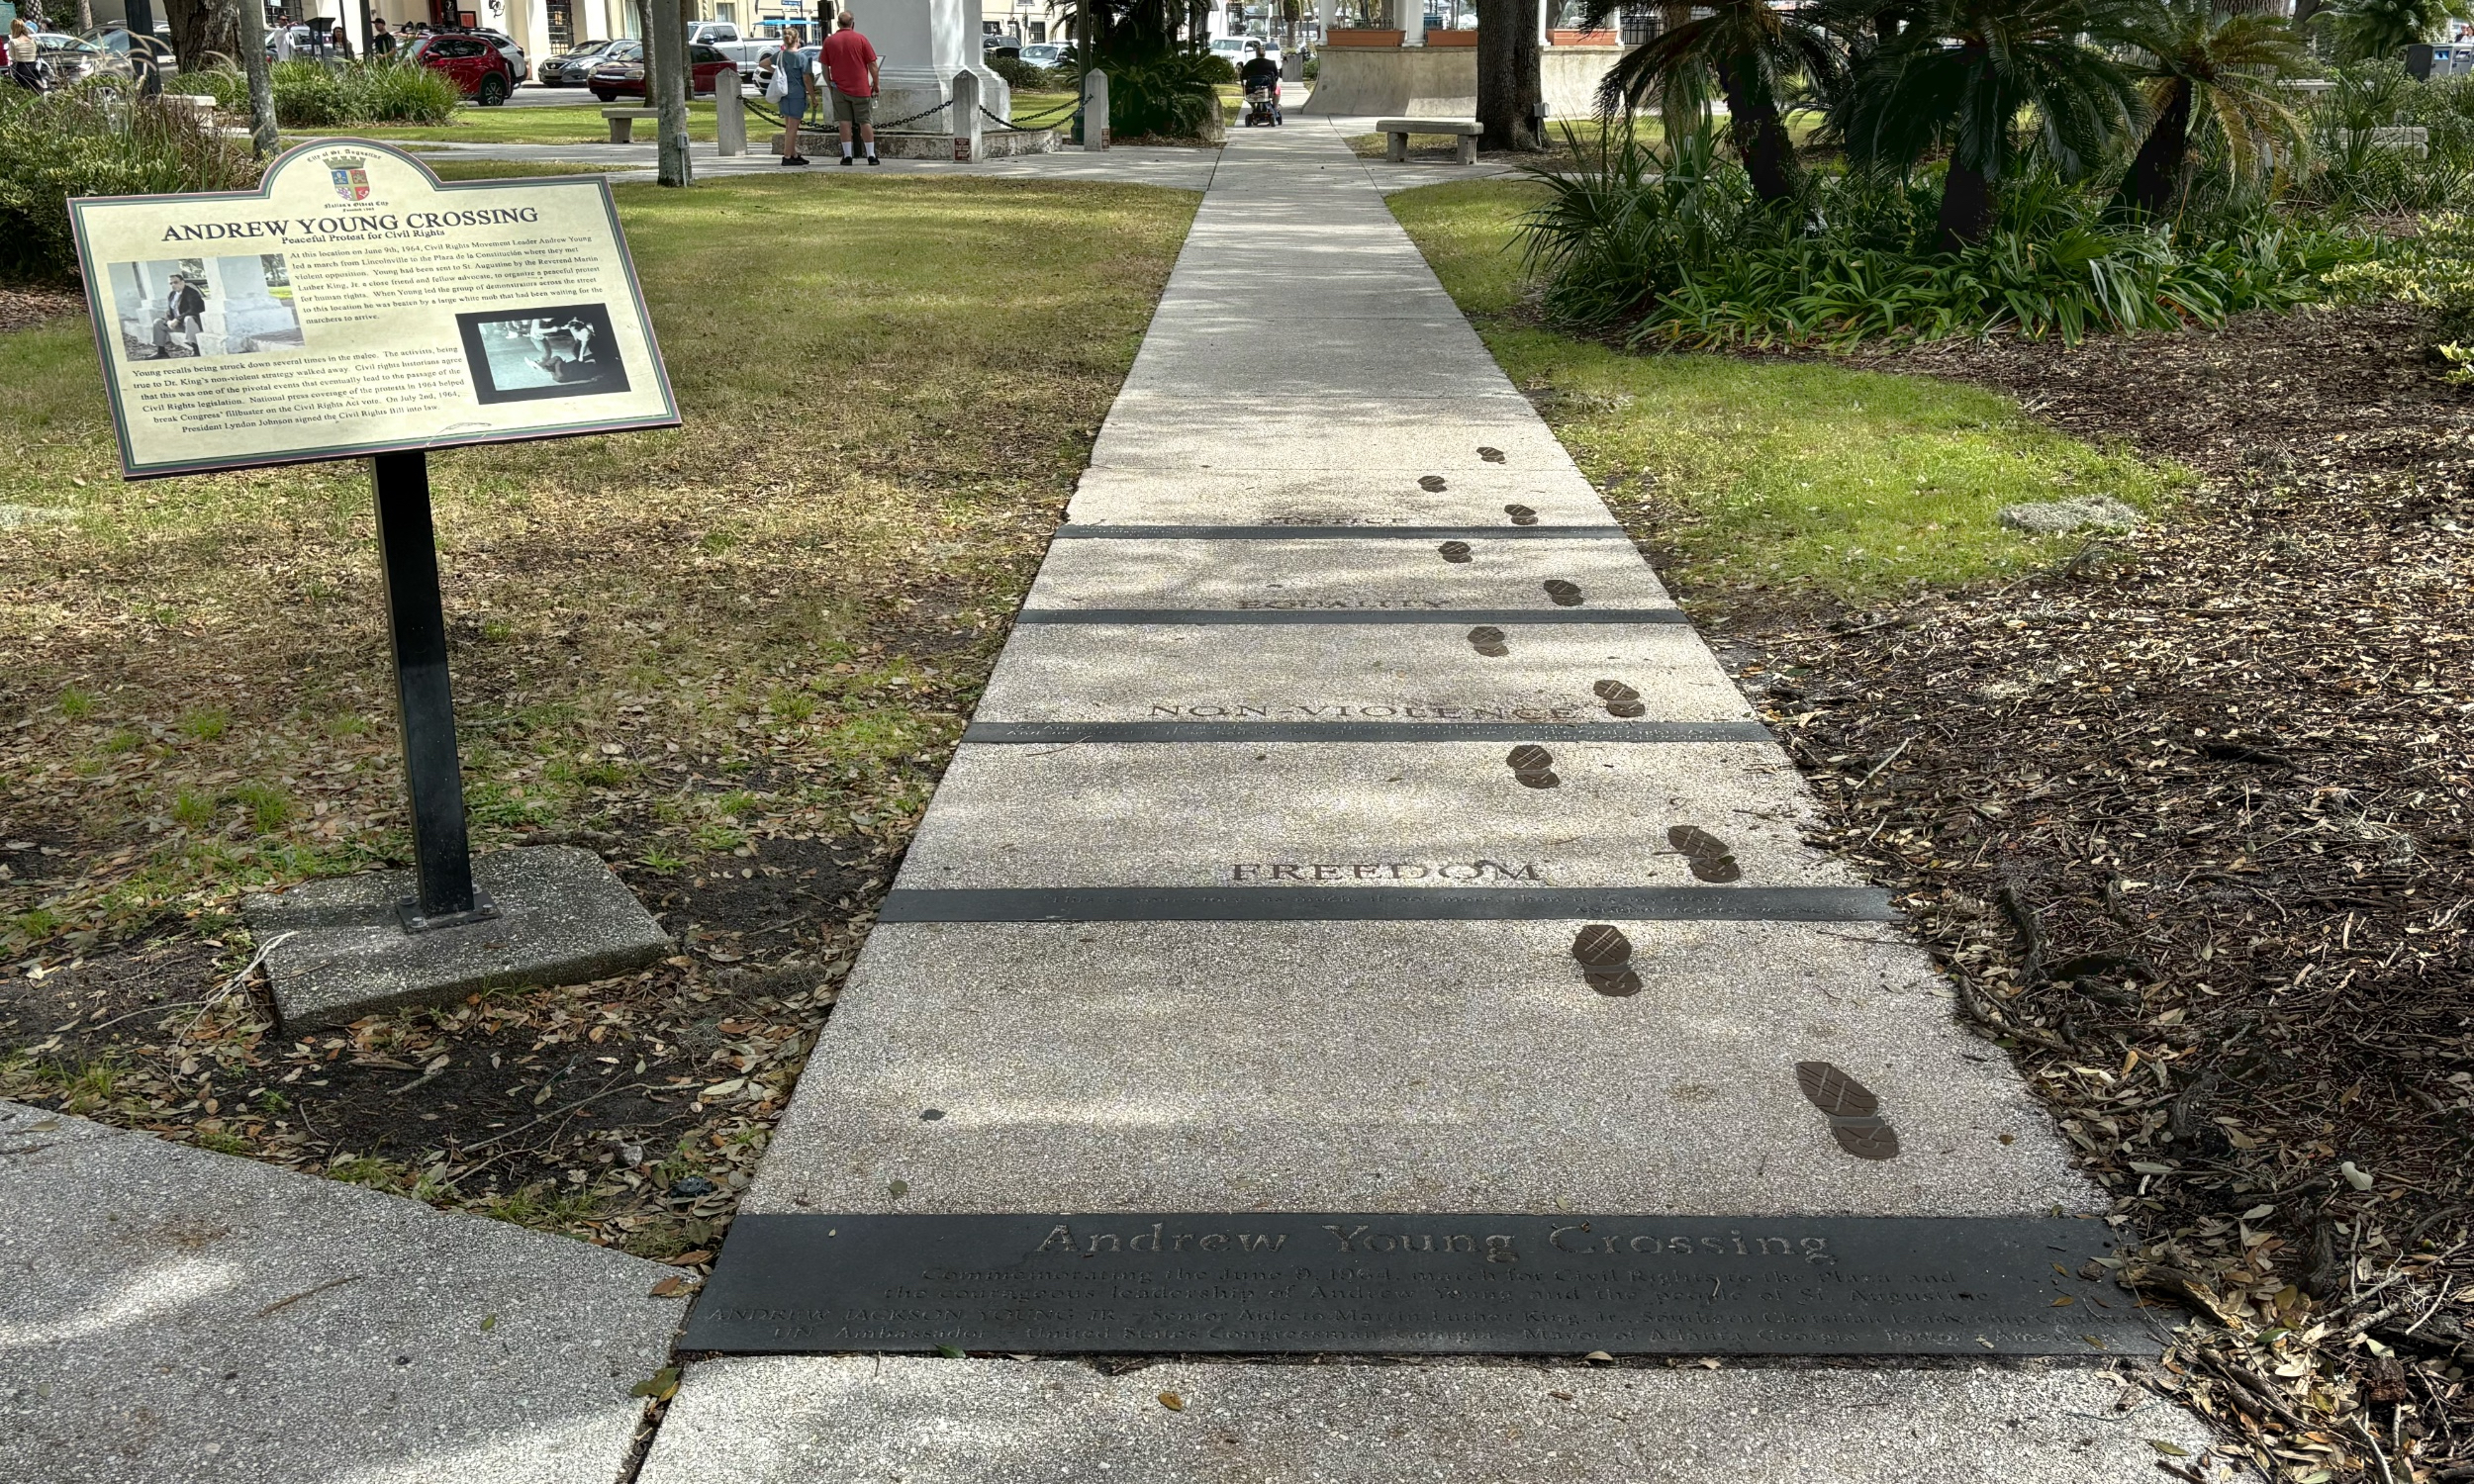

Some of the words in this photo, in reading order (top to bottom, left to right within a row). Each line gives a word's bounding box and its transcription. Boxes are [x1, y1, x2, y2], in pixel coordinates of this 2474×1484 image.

[161, 219, 291, 242] ANDREW
[295, 214, 400, 235] YOUNG
[405, 206, 539, 230] CROSSING
[281, 234, 327, 245] Peaceful
[328, 233, 366, 242] Protest
[367, 232, 383, 240] for
[384, 230, 411, 239] Civil
[412, 229, 445, 239] Rights
[360, 256, 409, 266] Lincolnville
[474, 261, 513, 270] Augustine
[537, 256, 573, 265] Reverend
[210, 373, 260, 384] non-violent
[296, 367, 327, 376] walked
[354, 363, 376, 372] Civil
[377, 362, 401, 371] rights
[142, 404, 165, 413] Civil
[166, 402, 196, 412] Rights
[196, 399, 245, 409] legislation.
[248, 394, 286, 404] National
[310, 390, 347, 399] coverage
[374, 385, 407, 395] protests
[437, 378, 465, 388] helped
[152, 416, 179, 424] break
[293, 403, 315, 412] Civil
[316, 401, 344, 411] Rights
[400, 394, 417, 403] July
[181, 423, 223, 433] President
[224, 420, 257, 430] Lyndon
[258, 417, 294, 426] Johnson
[294, 414, 323, 424] signed
[338, 411, 360, 419] Civil
[360, 409, 388, 417] Rights
[1147, 703, 1576, 723] NON-VIOLENCE
[1232, 861, 1541, 882] FREEDOM
[1035, 1223, 1289, 1252] Andrew
[1321, 1225, 1520, 1263] Young
[1550, 1226, 1839, 1265] Crossing
[921, 1267, 1153, 1283] Commemorating
[1165, 1267, 1207, 1281] the
[1219, 1267, 1282, 1281] June
[1411, 1268, 1497, 1281] march
[1506, 1267, 1544, 1281] for
[1554, 1267, 1618, 1282] Civil
[1762, 1270, 1805, 1283] the
[1818, 1270, 1891, 1284] Plaza
[1906, 1270, 1956, 1284] and
[884, 1286, 927, 1299] the
[937, 1288, 1095, 1302] courageous
[1111, 1285, 1255, 1302] leadership
[1267, 1284, 1295, 1299] of
[1308, 1285, 1415, 1300] Andrew
[1433, 1286, 1513, 1303] Young
[1528, 1286, 1579, 1301] and
[1594, 1286, 1638, 1301] the
[1758, 1288, 1784, 1302] of
